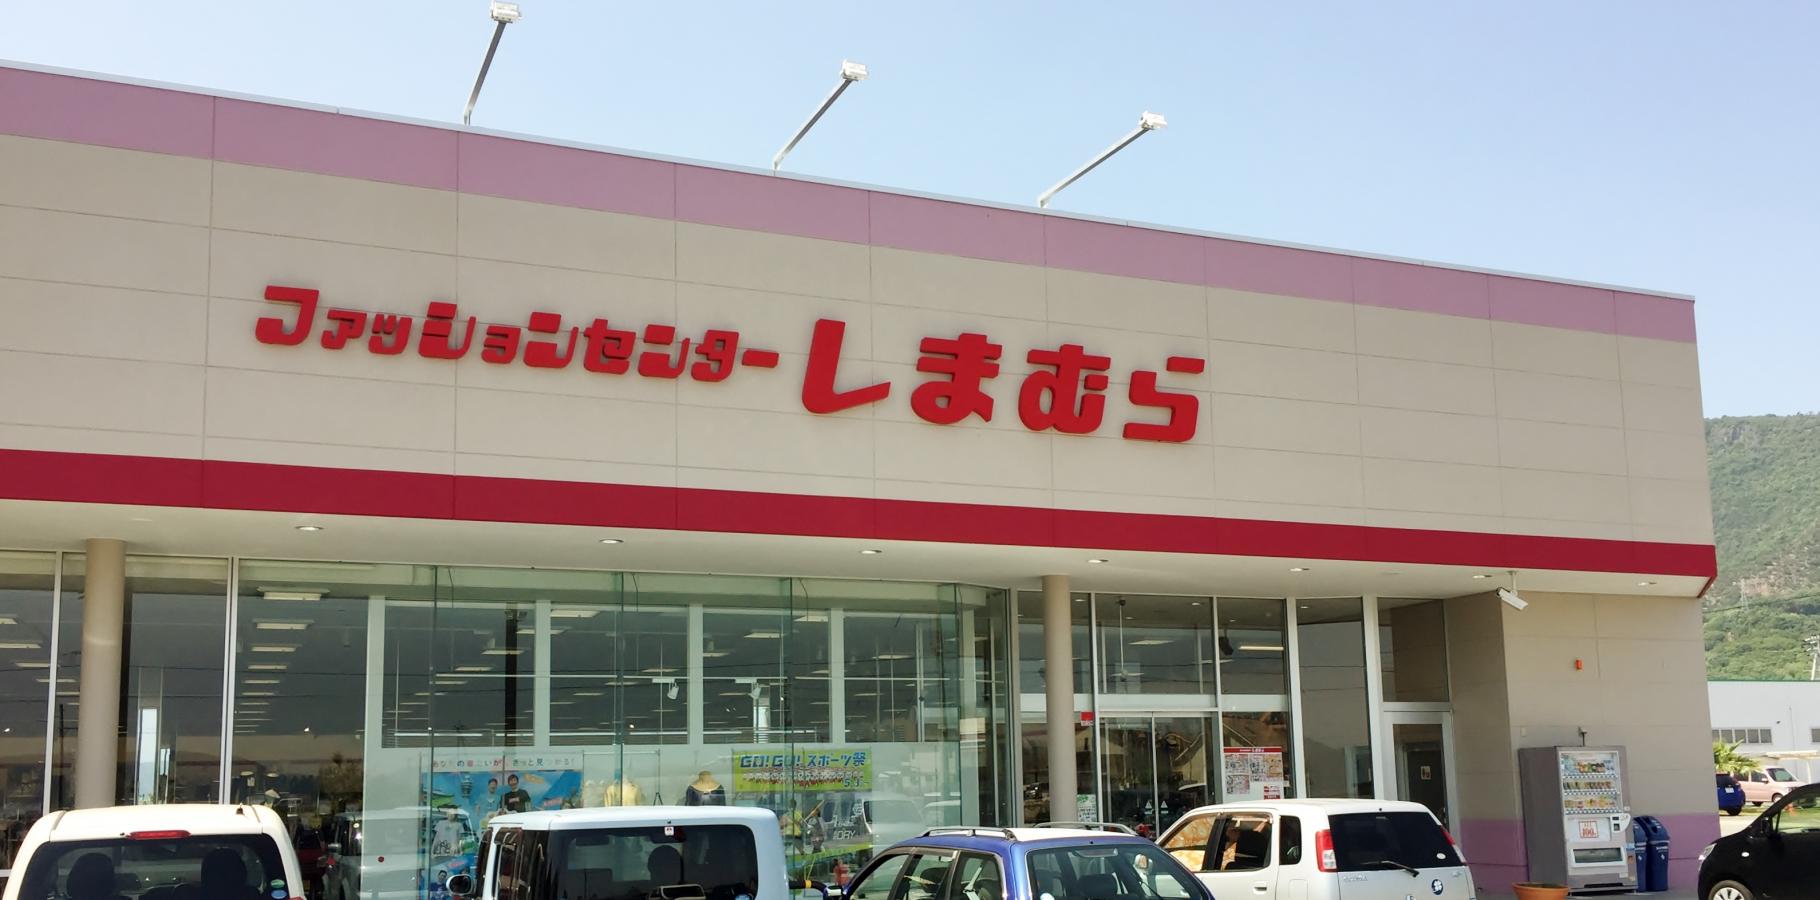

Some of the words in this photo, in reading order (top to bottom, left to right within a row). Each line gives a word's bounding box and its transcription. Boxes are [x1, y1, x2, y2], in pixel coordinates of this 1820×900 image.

[255, 285, 779, 382] ファッションセンター
[801, 318, 1205, 442] しまむら
[807, 752, 866, 767] スポーツ祭
